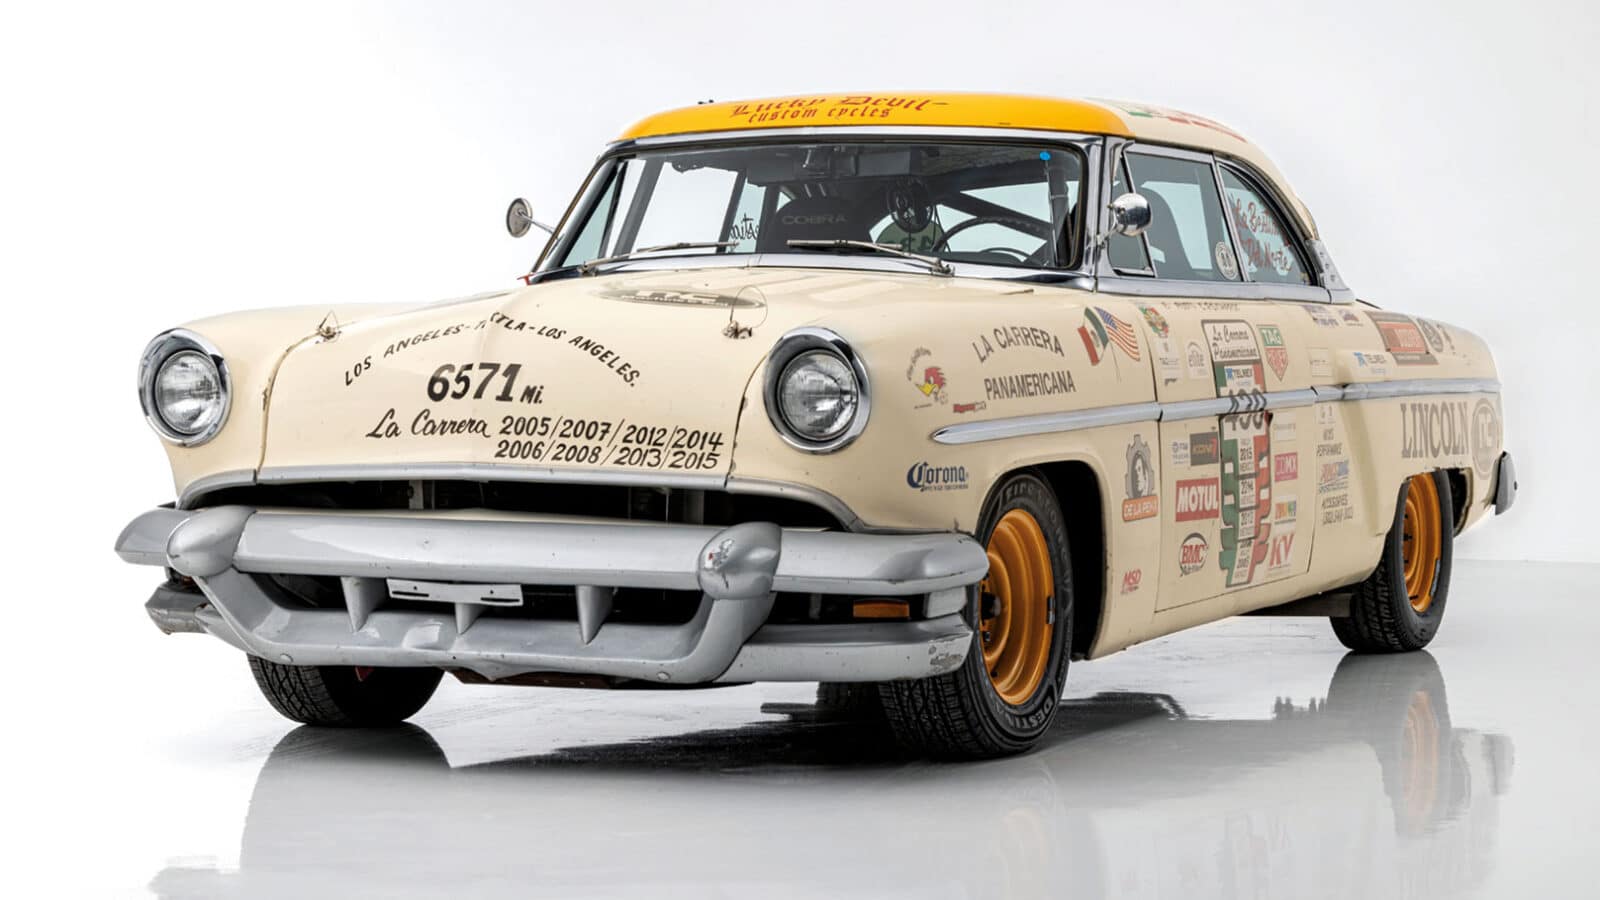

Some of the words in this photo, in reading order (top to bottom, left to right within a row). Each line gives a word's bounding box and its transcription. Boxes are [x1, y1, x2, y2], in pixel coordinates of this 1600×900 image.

[748, 106, 818, 124] custom
[827, 106, 891, 119] cycles
[782, 215, 847, 225] COBRA
[972, 334, 994, 363] LA
[993, 325, 1065, 358] CARRERA
[1261, 328, 1283, 345] TAG
[345, 355, 372, 386] LOS
[427, 362, 522, 402] 6571
[983, 370, 1077, 401] PANAMERICANA
[365, 408, 401, 439] La
[411, 408, 491, 439] Carrera
[1400, 401, 1469, 459] LINCOLN
[906, 461, 966, 492] Corona
[1177, 484, 1218, 514] MOTUL
[1181, 544, 1205, 565] BMC
[1270, 531, 1294, 567] KV
